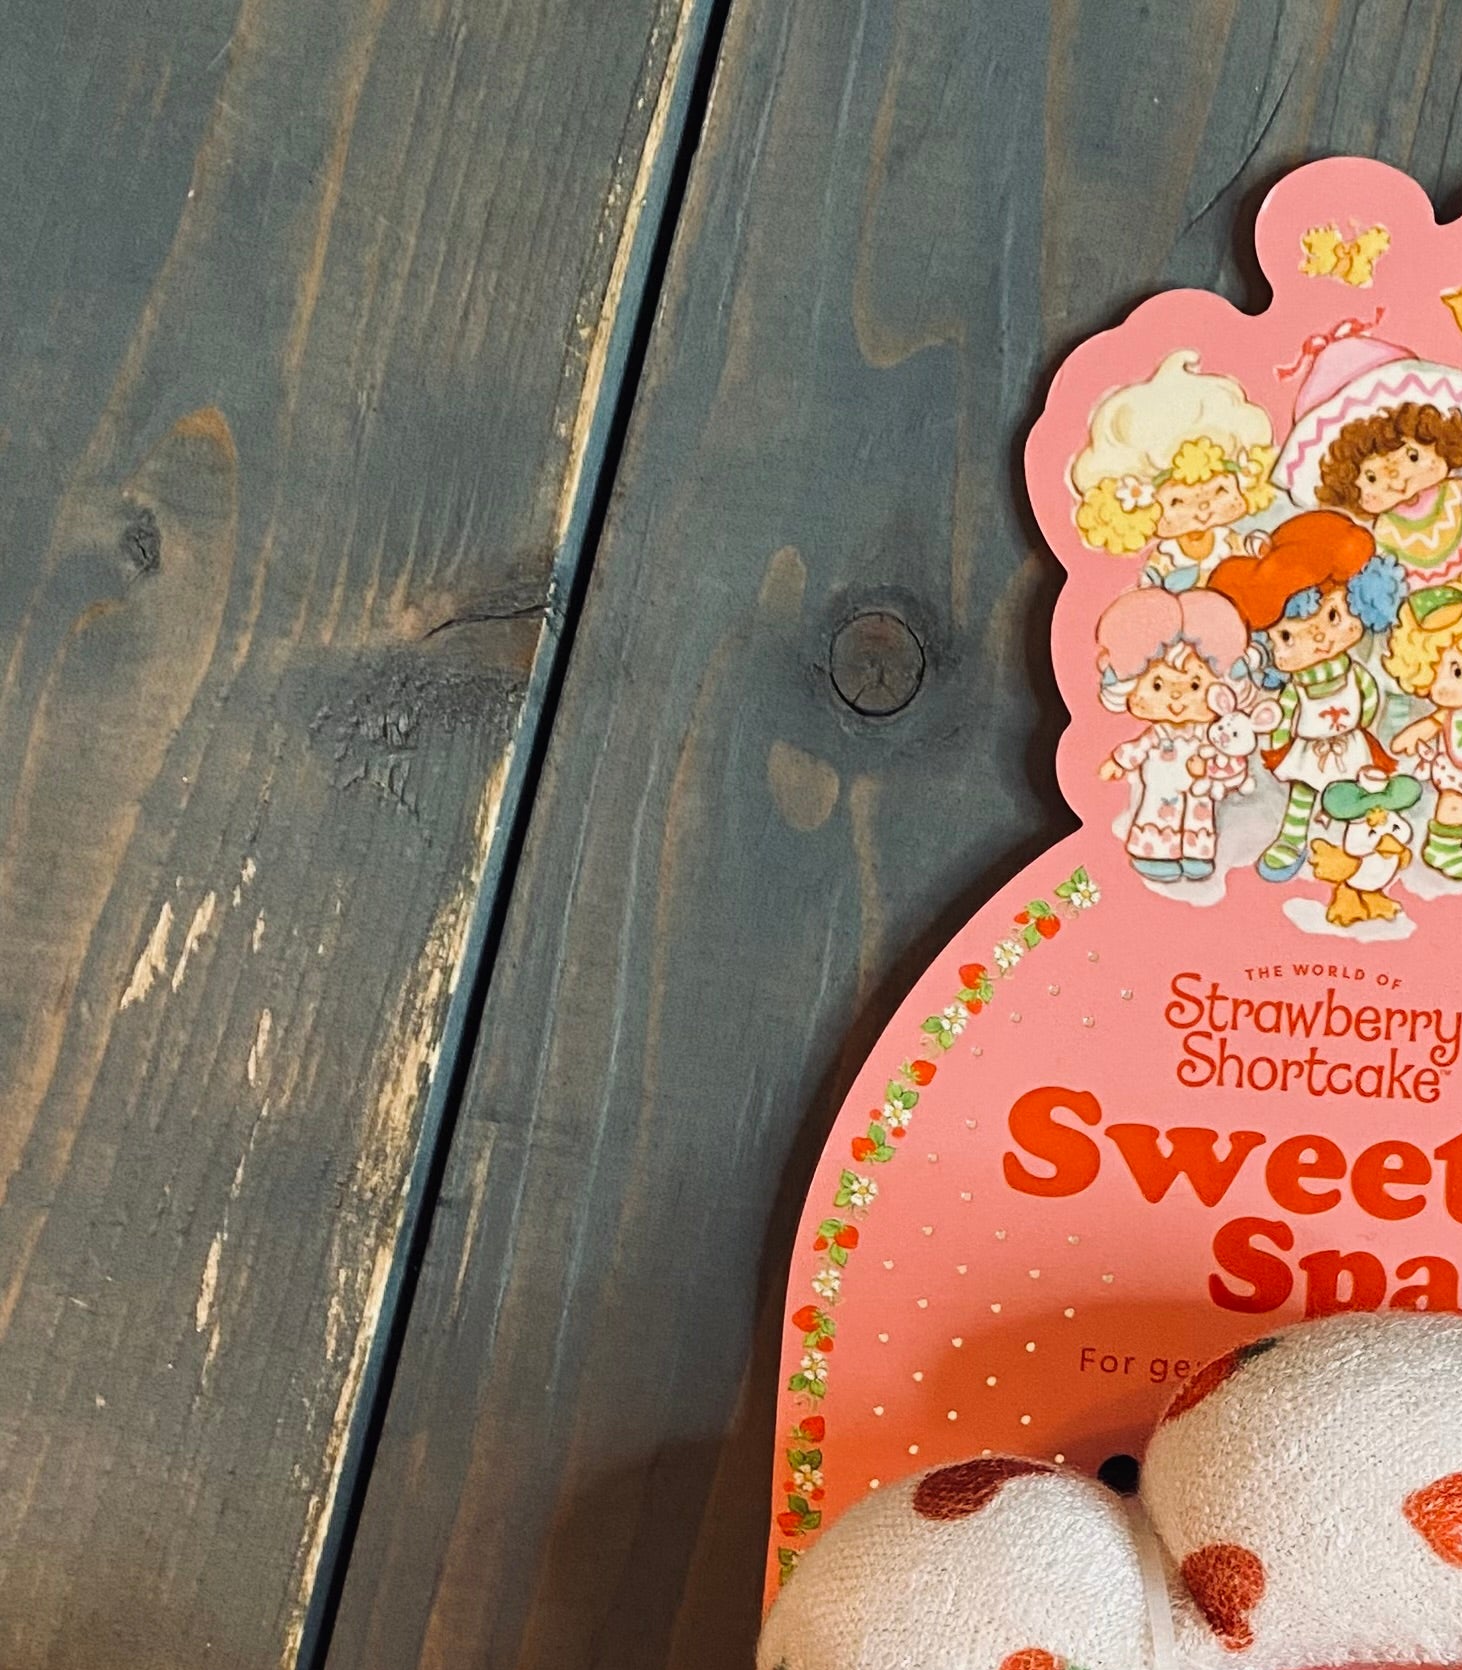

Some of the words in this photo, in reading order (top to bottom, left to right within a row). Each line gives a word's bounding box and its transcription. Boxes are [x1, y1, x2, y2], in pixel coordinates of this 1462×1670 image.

[1245, 967, 1283, 981] THE
[1292, 964, 1366, 981] WORLD
[1376, 973, 1403, 991] OF
[1164, 972, 1462, 1067] Strawberry
[1080, 1347, 1135, 1374] For
